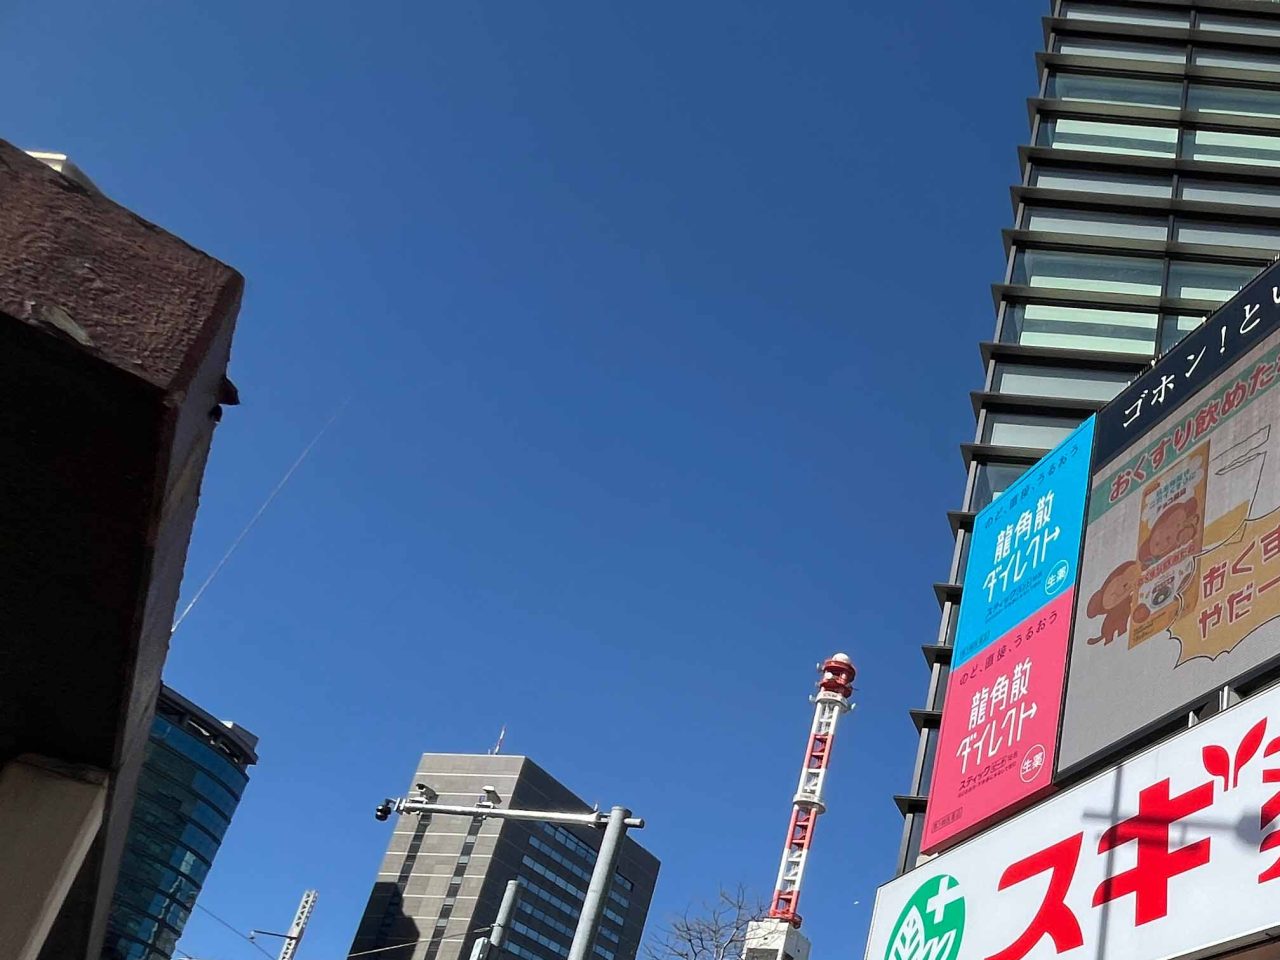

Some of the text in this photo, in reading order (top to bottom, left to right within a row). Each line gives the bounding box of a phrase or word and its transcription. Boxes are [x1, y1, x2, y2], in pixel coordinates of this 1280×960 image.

[982, 526, 1061, 603] ダイレクト
[994, 489, 1055, 565] 龍角散
[968, 656, 1033, 731] 龍角散
[955, 702, 1038, 774] ダイレクト
[1021, 751, 1044, 774] 生薬
